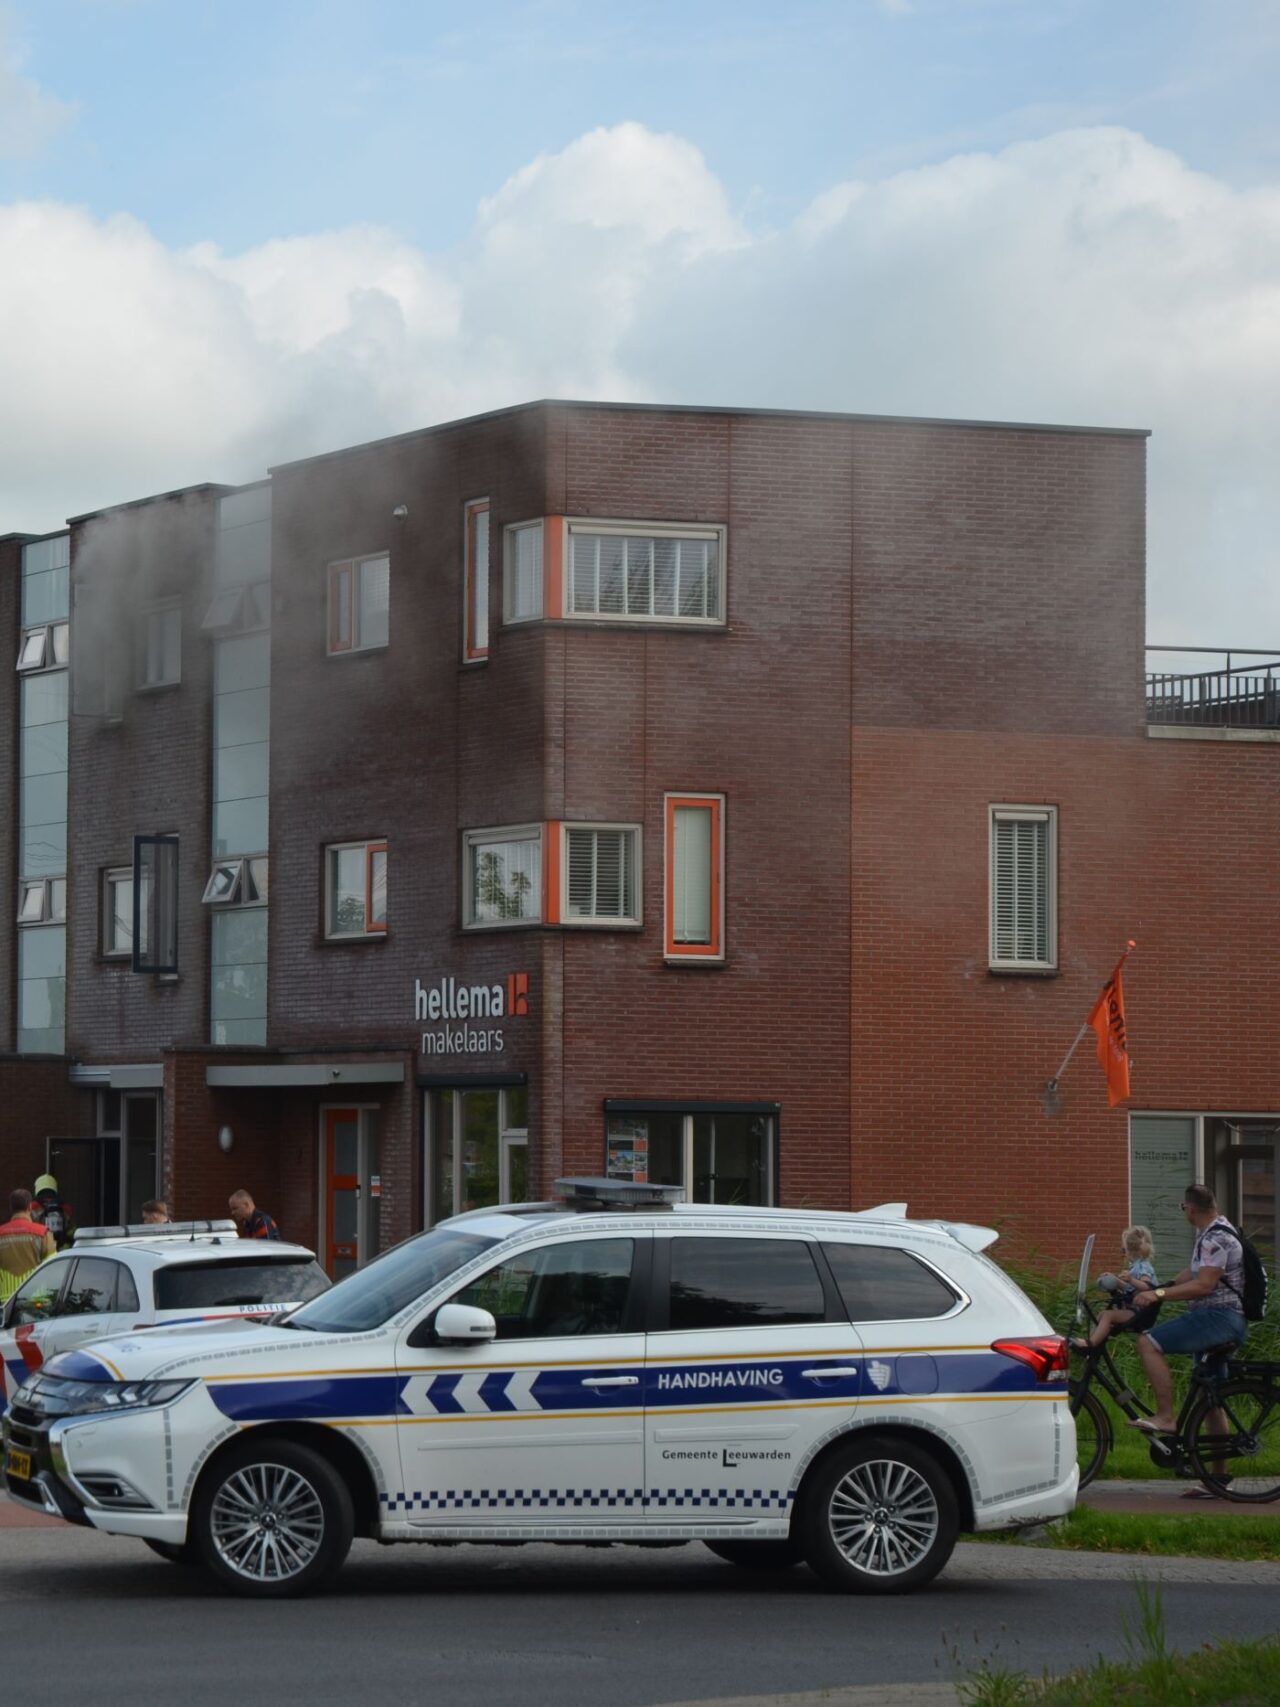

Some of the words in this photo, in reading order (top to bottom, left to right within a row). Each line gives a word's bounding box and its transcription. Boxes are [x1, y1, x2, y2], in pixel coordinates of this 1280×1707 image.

[415, 977, 504, 1020] hellema
[422, 1022, 504, 1054] makelaars
[239, 1303, 286, 1313] POLITIE
[658, 1368, 784, 1390] HANDHAVING
[662, 1450, 718, 1460] Gemeente
[722, 1448, 791, 1467] Leeuwarden
